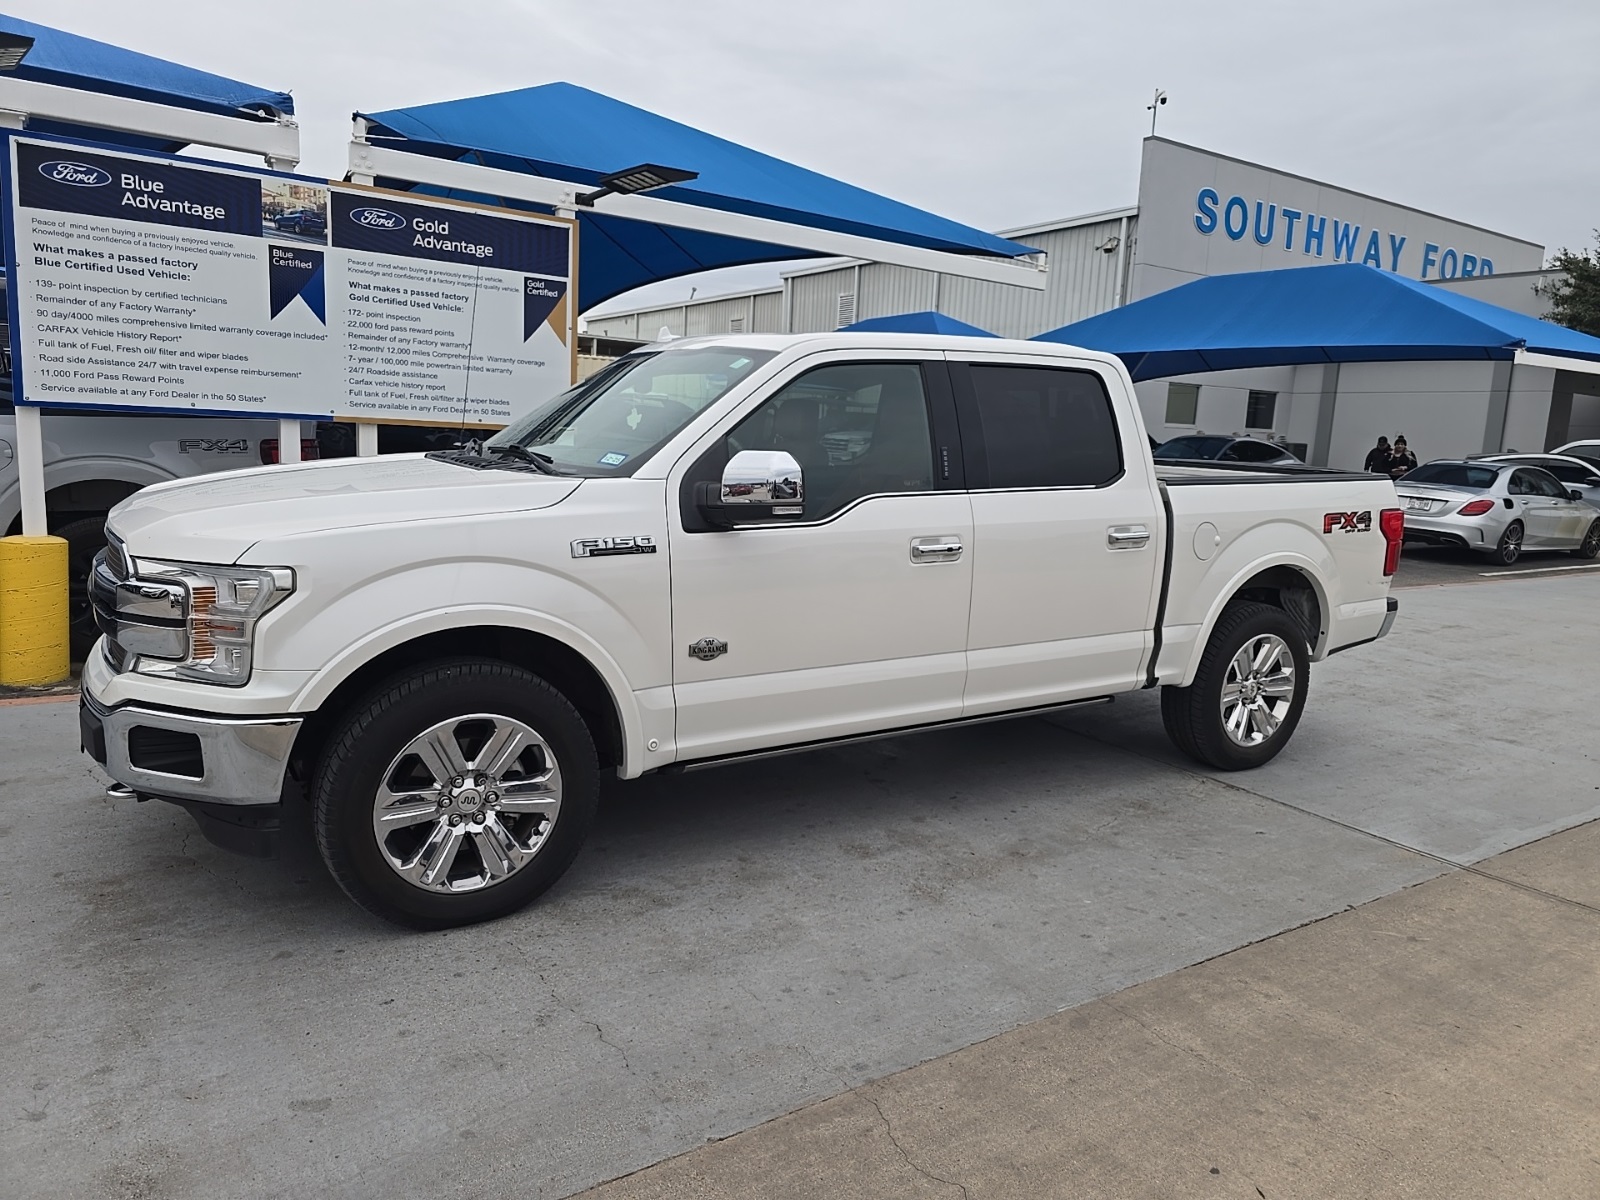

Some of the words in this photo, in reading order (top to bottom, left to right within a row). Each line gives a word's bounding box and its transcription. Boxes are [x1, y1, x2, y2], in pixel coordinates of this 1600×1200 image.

[53, 163, 98, 184] Ford
[121, 173, 164, 193] Blue
[121, 191, 225, 220] Advantage
[360, 210, 396, 228] Ford
[413, 218, 449, 235] Gold
[31, 217, 56, 227] Peace
[69, 223, 88, 231] mind
[89, 225, 110, 233] when
[111, 227, 136, 238] buying
[144, 232, 180, 243] previously
[181, 237, 209, 246] enjoyed
[1194, 187, 1407, 273] SOUTHWAY
[1420, 241, 1494, 280] FORD
[31, 227, 75, 239] Knowledge
[92, 235, 132, 245] confidence
[148, 241, 173, 251] factory
[174, 244, 208, 254] inspected
[209, 249, 232, 258] quality
[413, 233, 493, 258] Advantage
[33, 242, 64, 255] What
[67, 248, 105, 259] makes
[118, 254, 158, 265] passed
[160, 257, 198, 271] factory
[273, 249, 294, 259] Blue
[273, 257, 312, 269] Certified
[34, 256, 61, 268] Blue
[64, 259, 113, 273] Certified
[116, 265, 145, 277] Used
[147, 268, 190, 281] Vehicle:
[58, 282, 82, 291] point
[83, 283, 129, 295] inspection
[131, 288, 143, 298] by
[144, 291, 179, 300] certified
[180, 294, 228, 305] technicians
[348, 280, 371, 291] What
[373, 285, 401, 294] makes
[410, 289, 440, 298] passed
[441, 291, 469, 303] factory
[527, 280, 545, 288] Gold
[527, 287, 558, 297] Certified
[35, 293, 87, 306] Remainder
[88, 299, 98, 307] of
[100, 301, 117, 310] any
[119, 301, 152, 313] Factory
[349, 293, 370, 303] Gold
[372, 295, 408, 307] Certified
[410, 300, 431, 309] Used
[432, 302, 464, 313] Vehicle:
[36, 308, 49, 318] 90
[50, 310, 94, 321] day/4000
[96, 315, 120, 323] miles
[122, 317, 188, 329] comprehensive
[189, 322, 217, 332] limited
[218, 326, 254, 337] warranty
[255, 329, 292, 339] coverage
[365, 311, 384, 319] point
[385, 312, 421, 322] inspection
[37, 323, 79, 335] CARFAX
[81, 327, 114, 338] Vehicle
[116, 330, 148, 342] History
[347, 320, 373, 329] 22,000
[374, 322, 389, 331] ford
[390, 325, 408, 333] pass
[408, 327, 433, 335] reward
[347, 331, 388, 342] Remainder
[388, 335, 397, 343] of
[397, 337, 411, 345] any
[412, 337, 439, 348] Factory
[38, 338, 55, 347] Full
[58, 340, 78, 349] tank
[79, 342, 89, 350] of
[91, 342, 114, 353] Fuel,
[116, 344, 142, 354] Fresh
[158, 347, 178, 356] filter
[179, 350, 196, 358] and
[197, 351, 220, 360] wiper
[222, 353, 249, 362] blades
[387, 346, 411, 355] 12,000
[412, 349, 431, 357] miles
[486, 355, 516, 365] Warranty
[516, 359, 545, 368] coverage
[39, 353, 64, 363] Road
[66, 356, 86, 364] side
[87, 357, 136, 368] Assistance
[138, 360, 157, 369] 24/7
[159, 362, 177, 370] with
[178, 363, 202, 372] travel
[204, 366, 239, 375] expense
[348, 366, 365, 374] 24/7
[366, 367, 400, 377] Roadside
[401, 372, 438, 380] assistance
[380, 357, 409, 367] 100,000
[410, 360, 425, 368] mile
[426, 362, 462, 370] powertrain
[485, 367, 513, 376] warranty
[40, 369, 71, 378] 11,000
[73, 370, 95, 379] Ford
[97, 372, 120, 381] Pass
[122, 373, 156, 383] Reward
[158, 375, 185, 385] Points
[348, 377, 373, 386] Carfax
[374, 380, 400, 388] vehicle
[401, 382, 424, 391] history
[40, 383, 75, 393] Service
[77, 386, 118, 395] available
[120, 388, 129, 396] at
[130, 389, 147, 398] any
[149, 389, 169, 398] Ford
[171, 390, 199, 399] Dealer
[201, 392, 209, 400] in
[210, 393, 224, 401] the
[226, 393, 237, 402] 50
[349, 400, 377, 409] Service
[377, 403, 409, 411] available
[432, 405, 449, 413] Ford
[178, 439, 248, 454] FX4
[1323, 510, 1372, 534] FX4
[692, 645, 708, 655] KING
